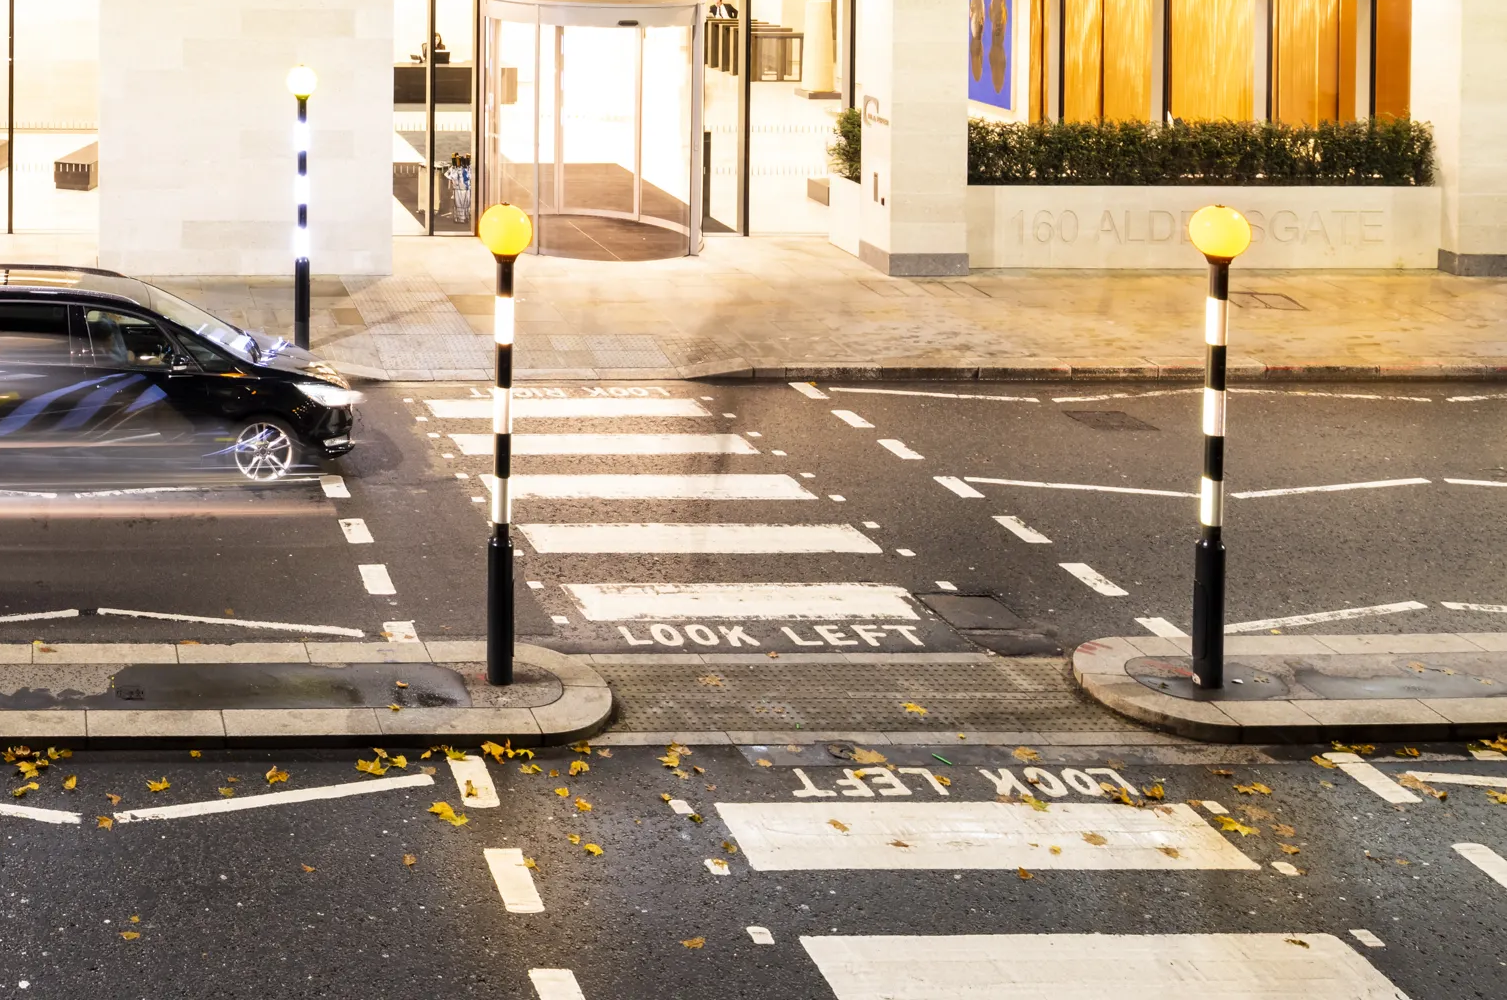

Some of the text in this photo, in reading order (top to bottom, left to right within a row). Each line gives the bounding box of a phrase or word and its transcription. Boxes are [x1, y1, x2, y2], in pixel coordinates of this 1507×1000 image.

[1011, 209, 1385, 245] 160 ALDESGATE
[618, 624, 924, 646] LOOK LEFT
[793, 767, 1140, 797] LOOK LEFT
